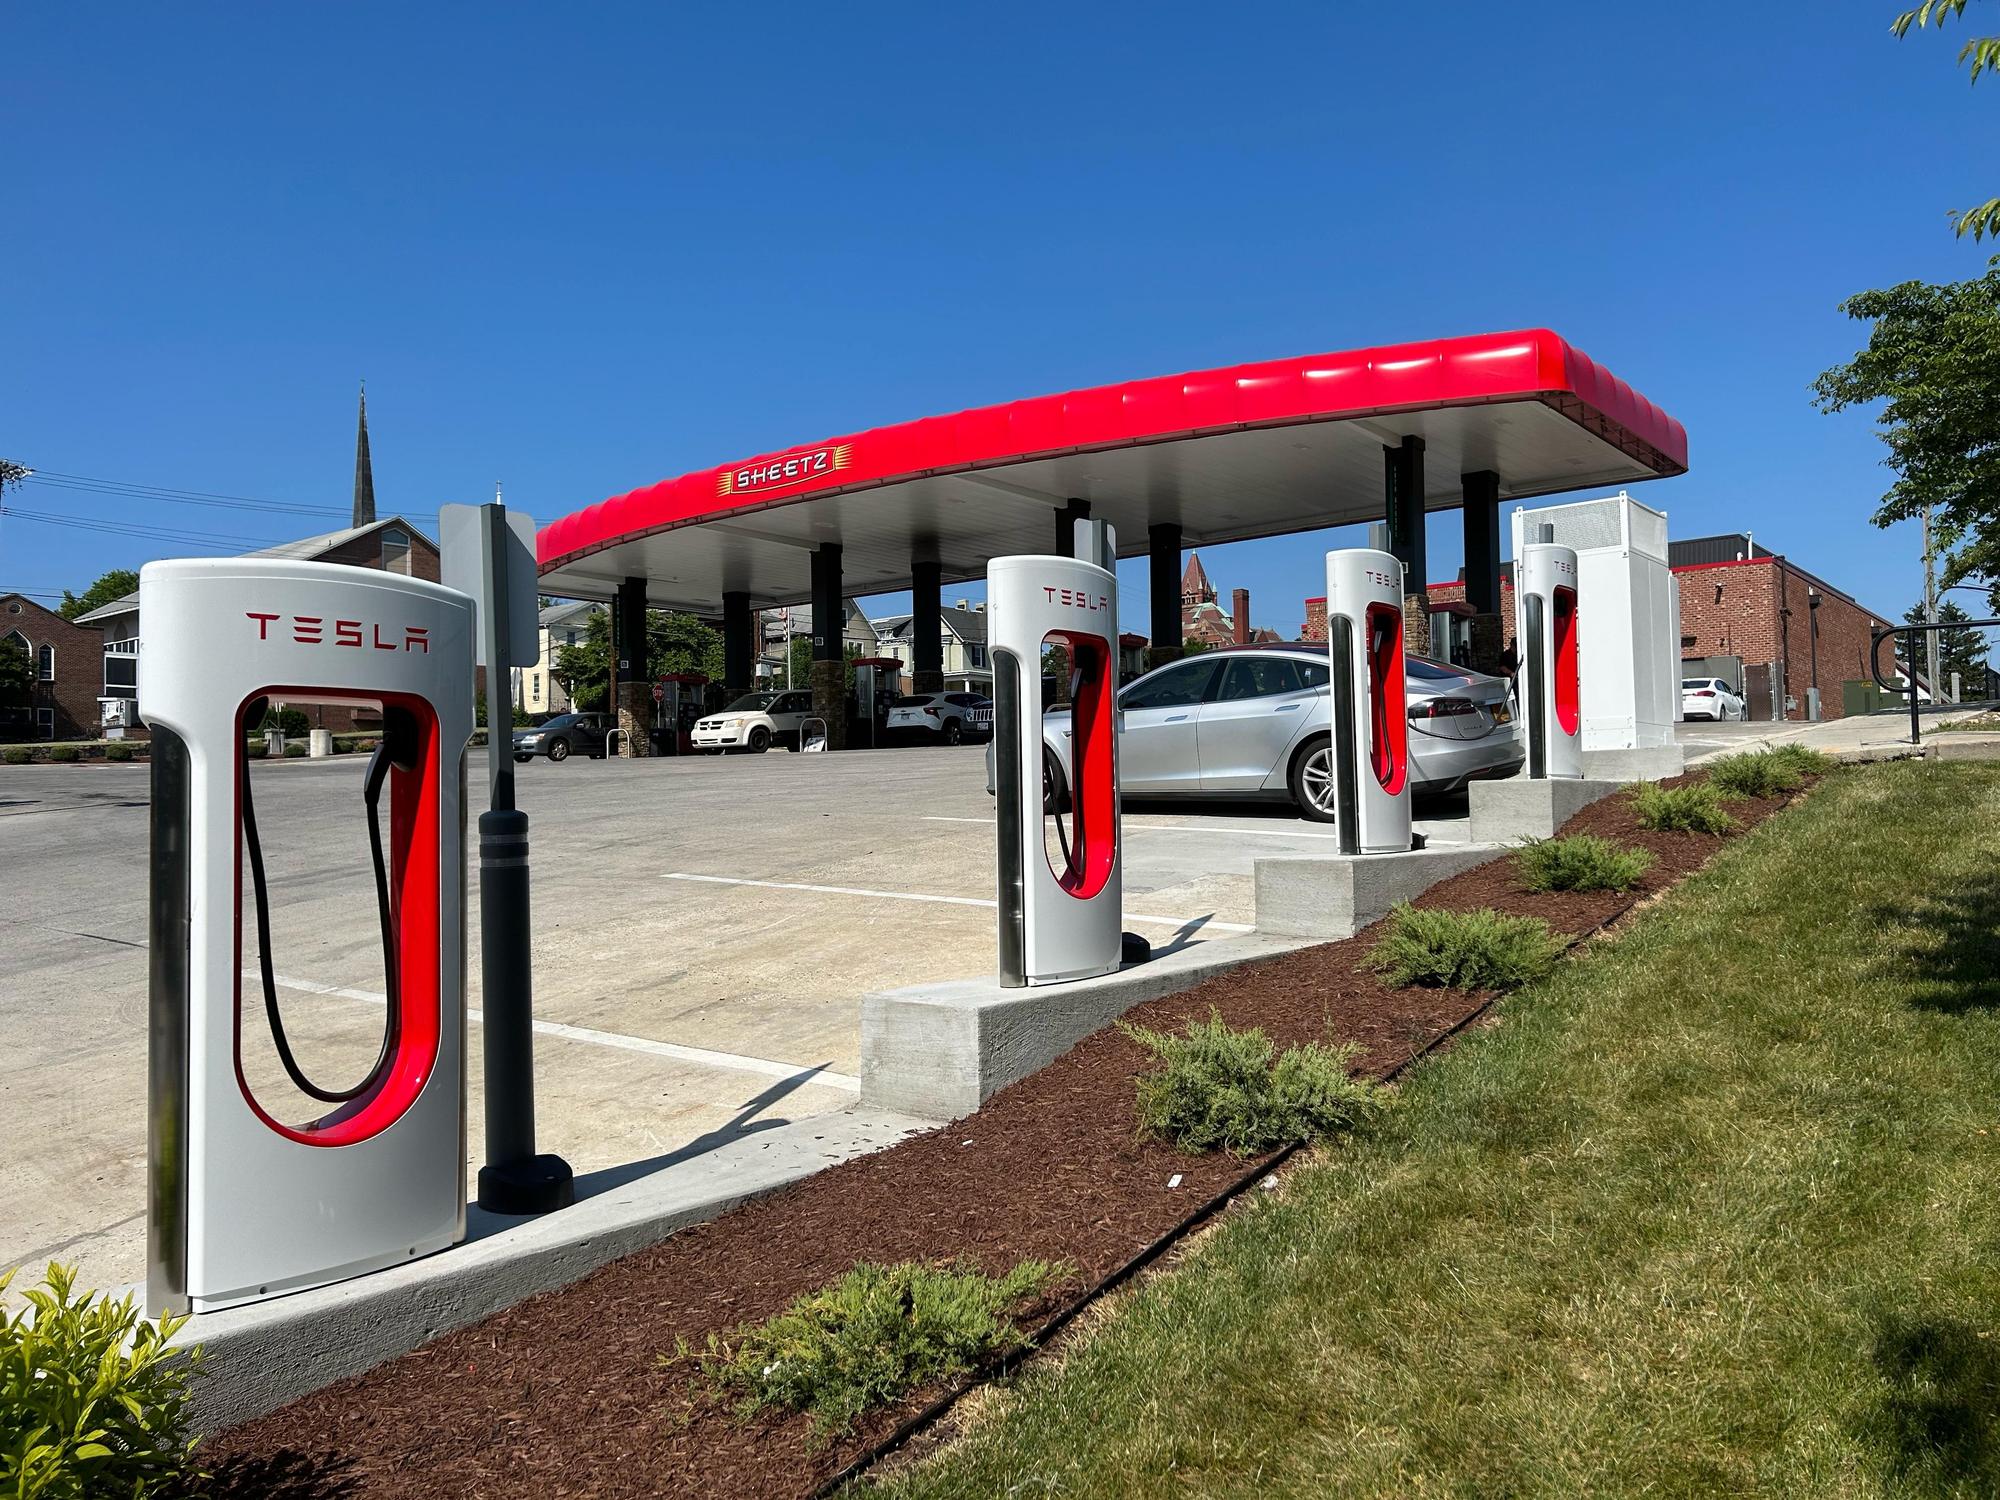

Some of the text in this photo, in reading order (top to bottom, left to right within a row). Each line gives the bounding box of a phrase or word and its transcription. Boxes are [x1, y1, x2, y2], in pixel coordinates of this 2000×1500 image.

[737, 452, 828, 488] SHEETZ
[1365, 570, 1400, 590] TESLA
[1043, 587, 1108, 613] TESLA
[245, 612, 430, 654] TESLA
